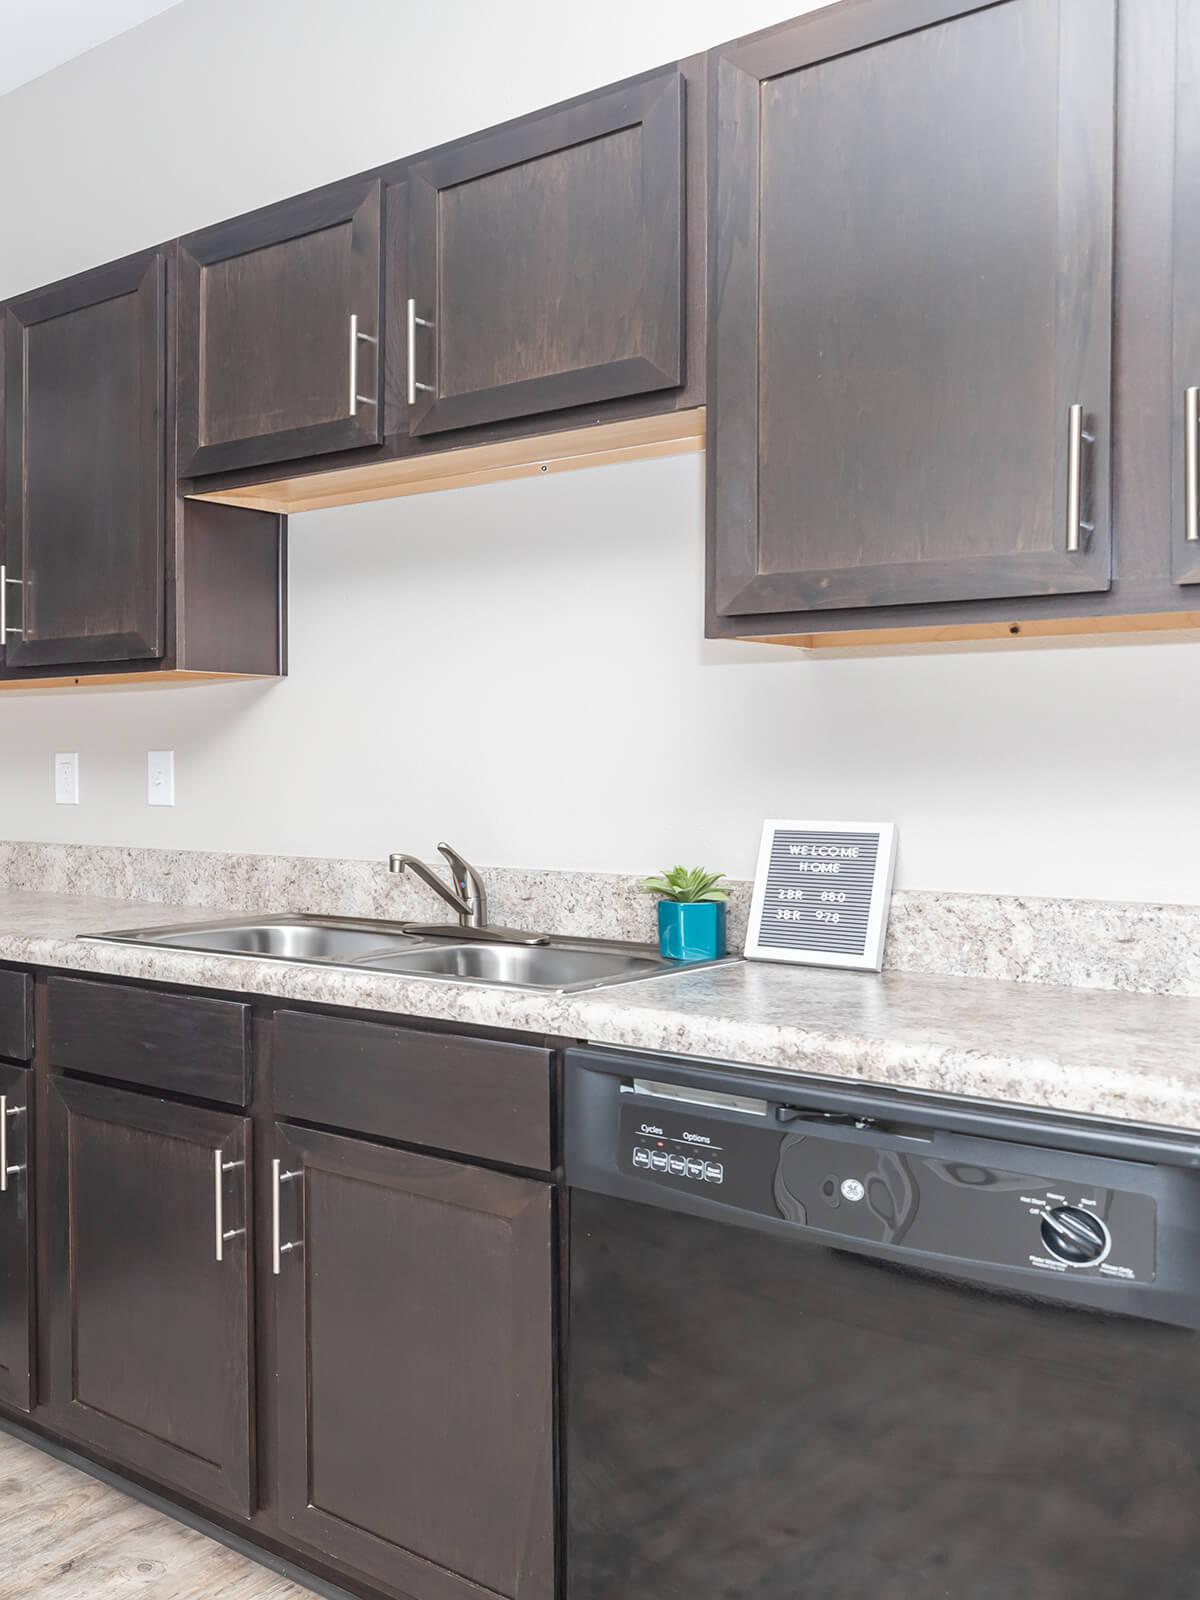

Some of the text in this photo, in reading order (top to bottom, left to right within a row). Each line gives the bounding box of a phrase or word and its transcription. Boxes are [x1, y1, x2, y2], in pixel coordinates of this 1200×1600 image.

[789, 845, 859, 858] WELCOME
[799, 861, 841, 873] HOME
[640, 1124, 663, 1135] Cycles
[682, 1132, 711, 1144] Options
